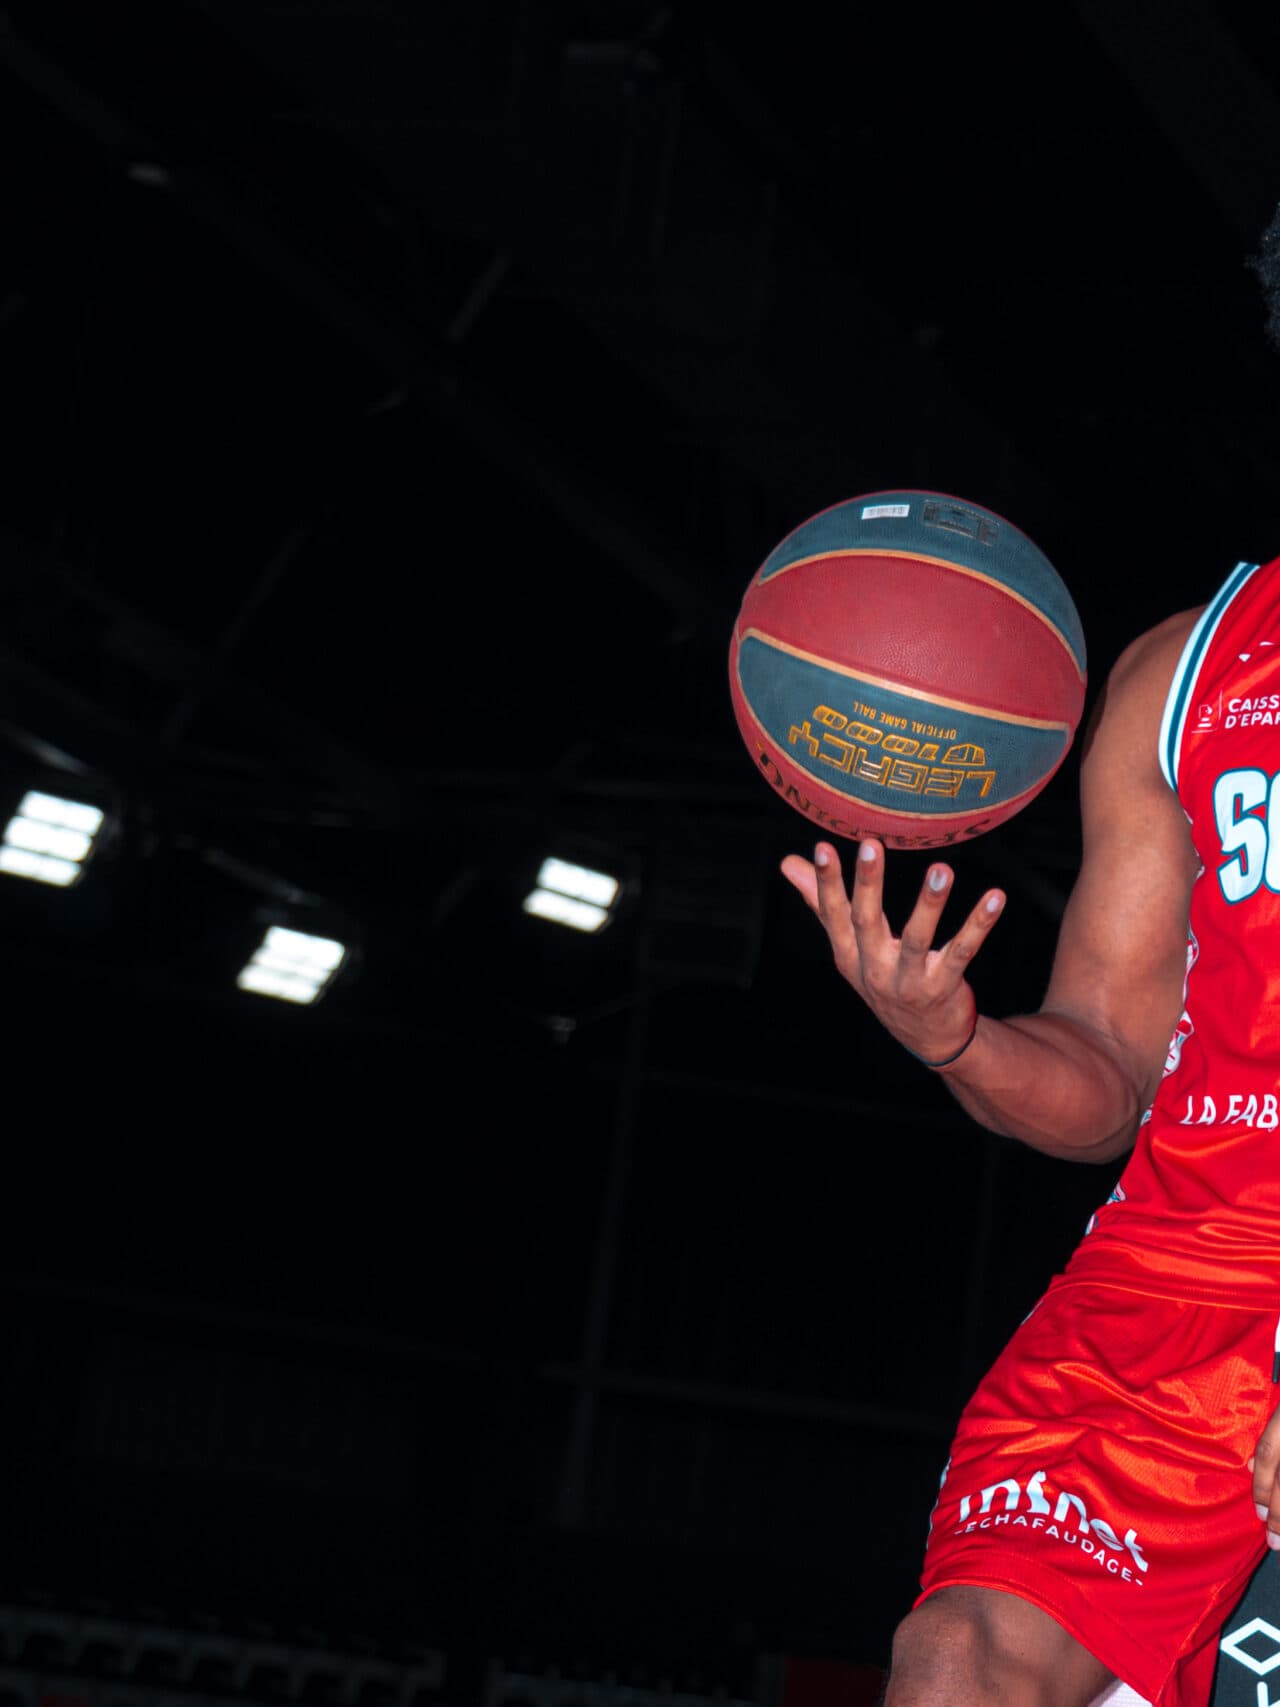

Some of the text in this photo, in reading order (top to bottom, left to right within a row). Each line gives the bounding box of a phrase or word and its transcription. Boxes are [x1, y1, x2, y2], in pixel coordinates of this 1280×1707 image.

[812, 704, 941, 761] 1000
[853, 700, 957, 741] OFFICIAL GAME BALL
[788, 720, 996, 798] LEGACY
[1180, 1095, 1217, 1125] LA
